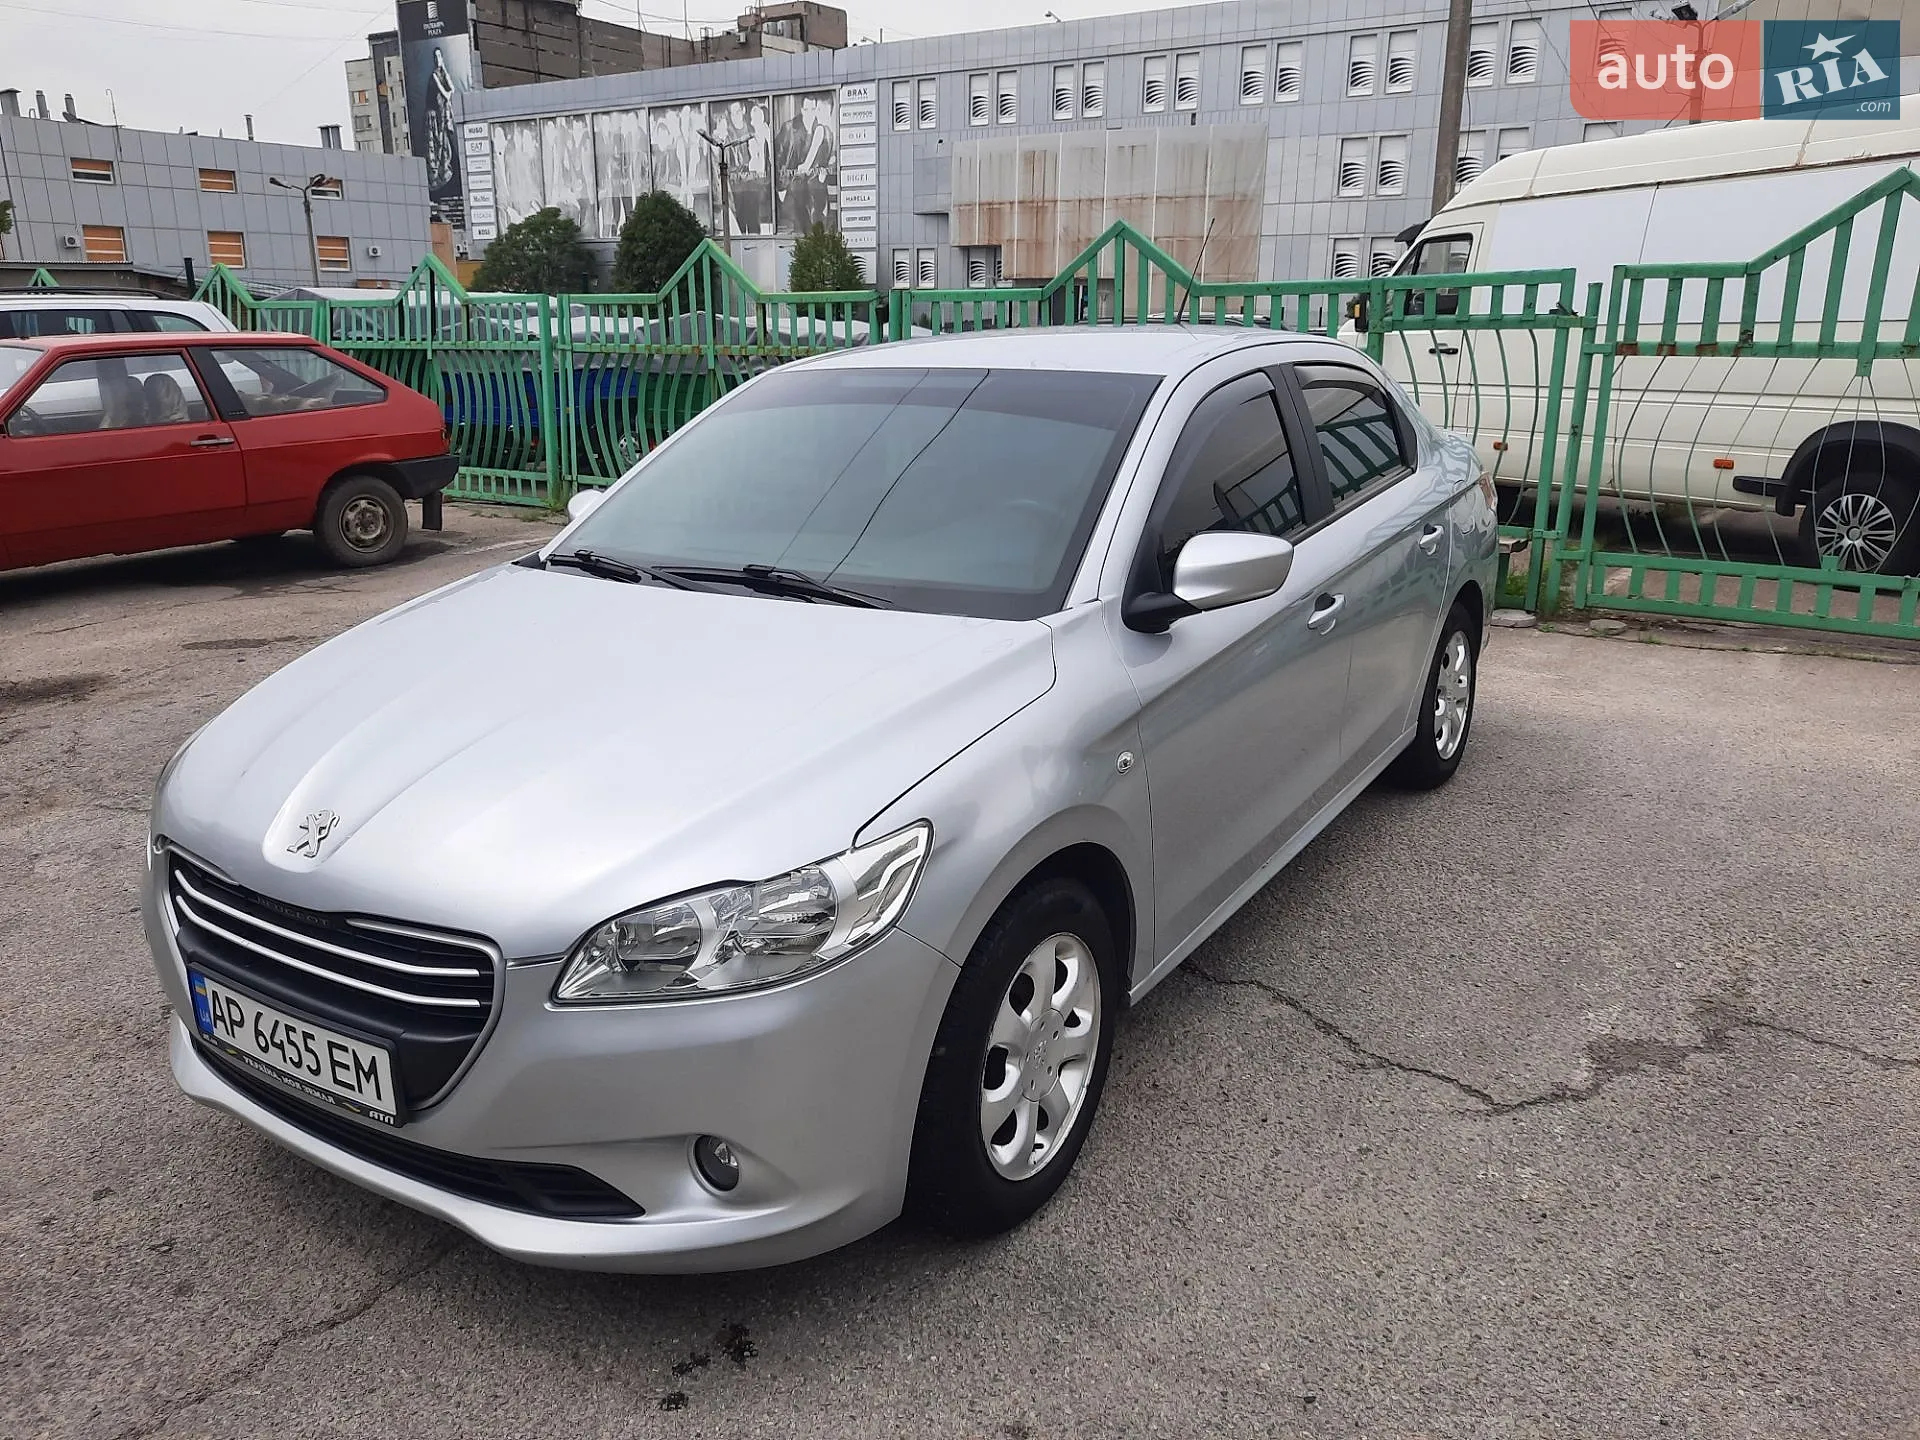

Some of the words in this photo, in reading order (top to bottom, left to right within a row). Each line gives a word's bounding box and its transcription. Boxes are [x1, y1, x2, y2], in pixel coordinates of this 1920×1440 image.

[847, 88, 868, 98] BRAX
[199, 1007, 211, 1024] UA
[211, 988, 245, 1039] AP
[253, 1010, 321, 1077] 6455
[327, 1040, 383, 1101] EM
